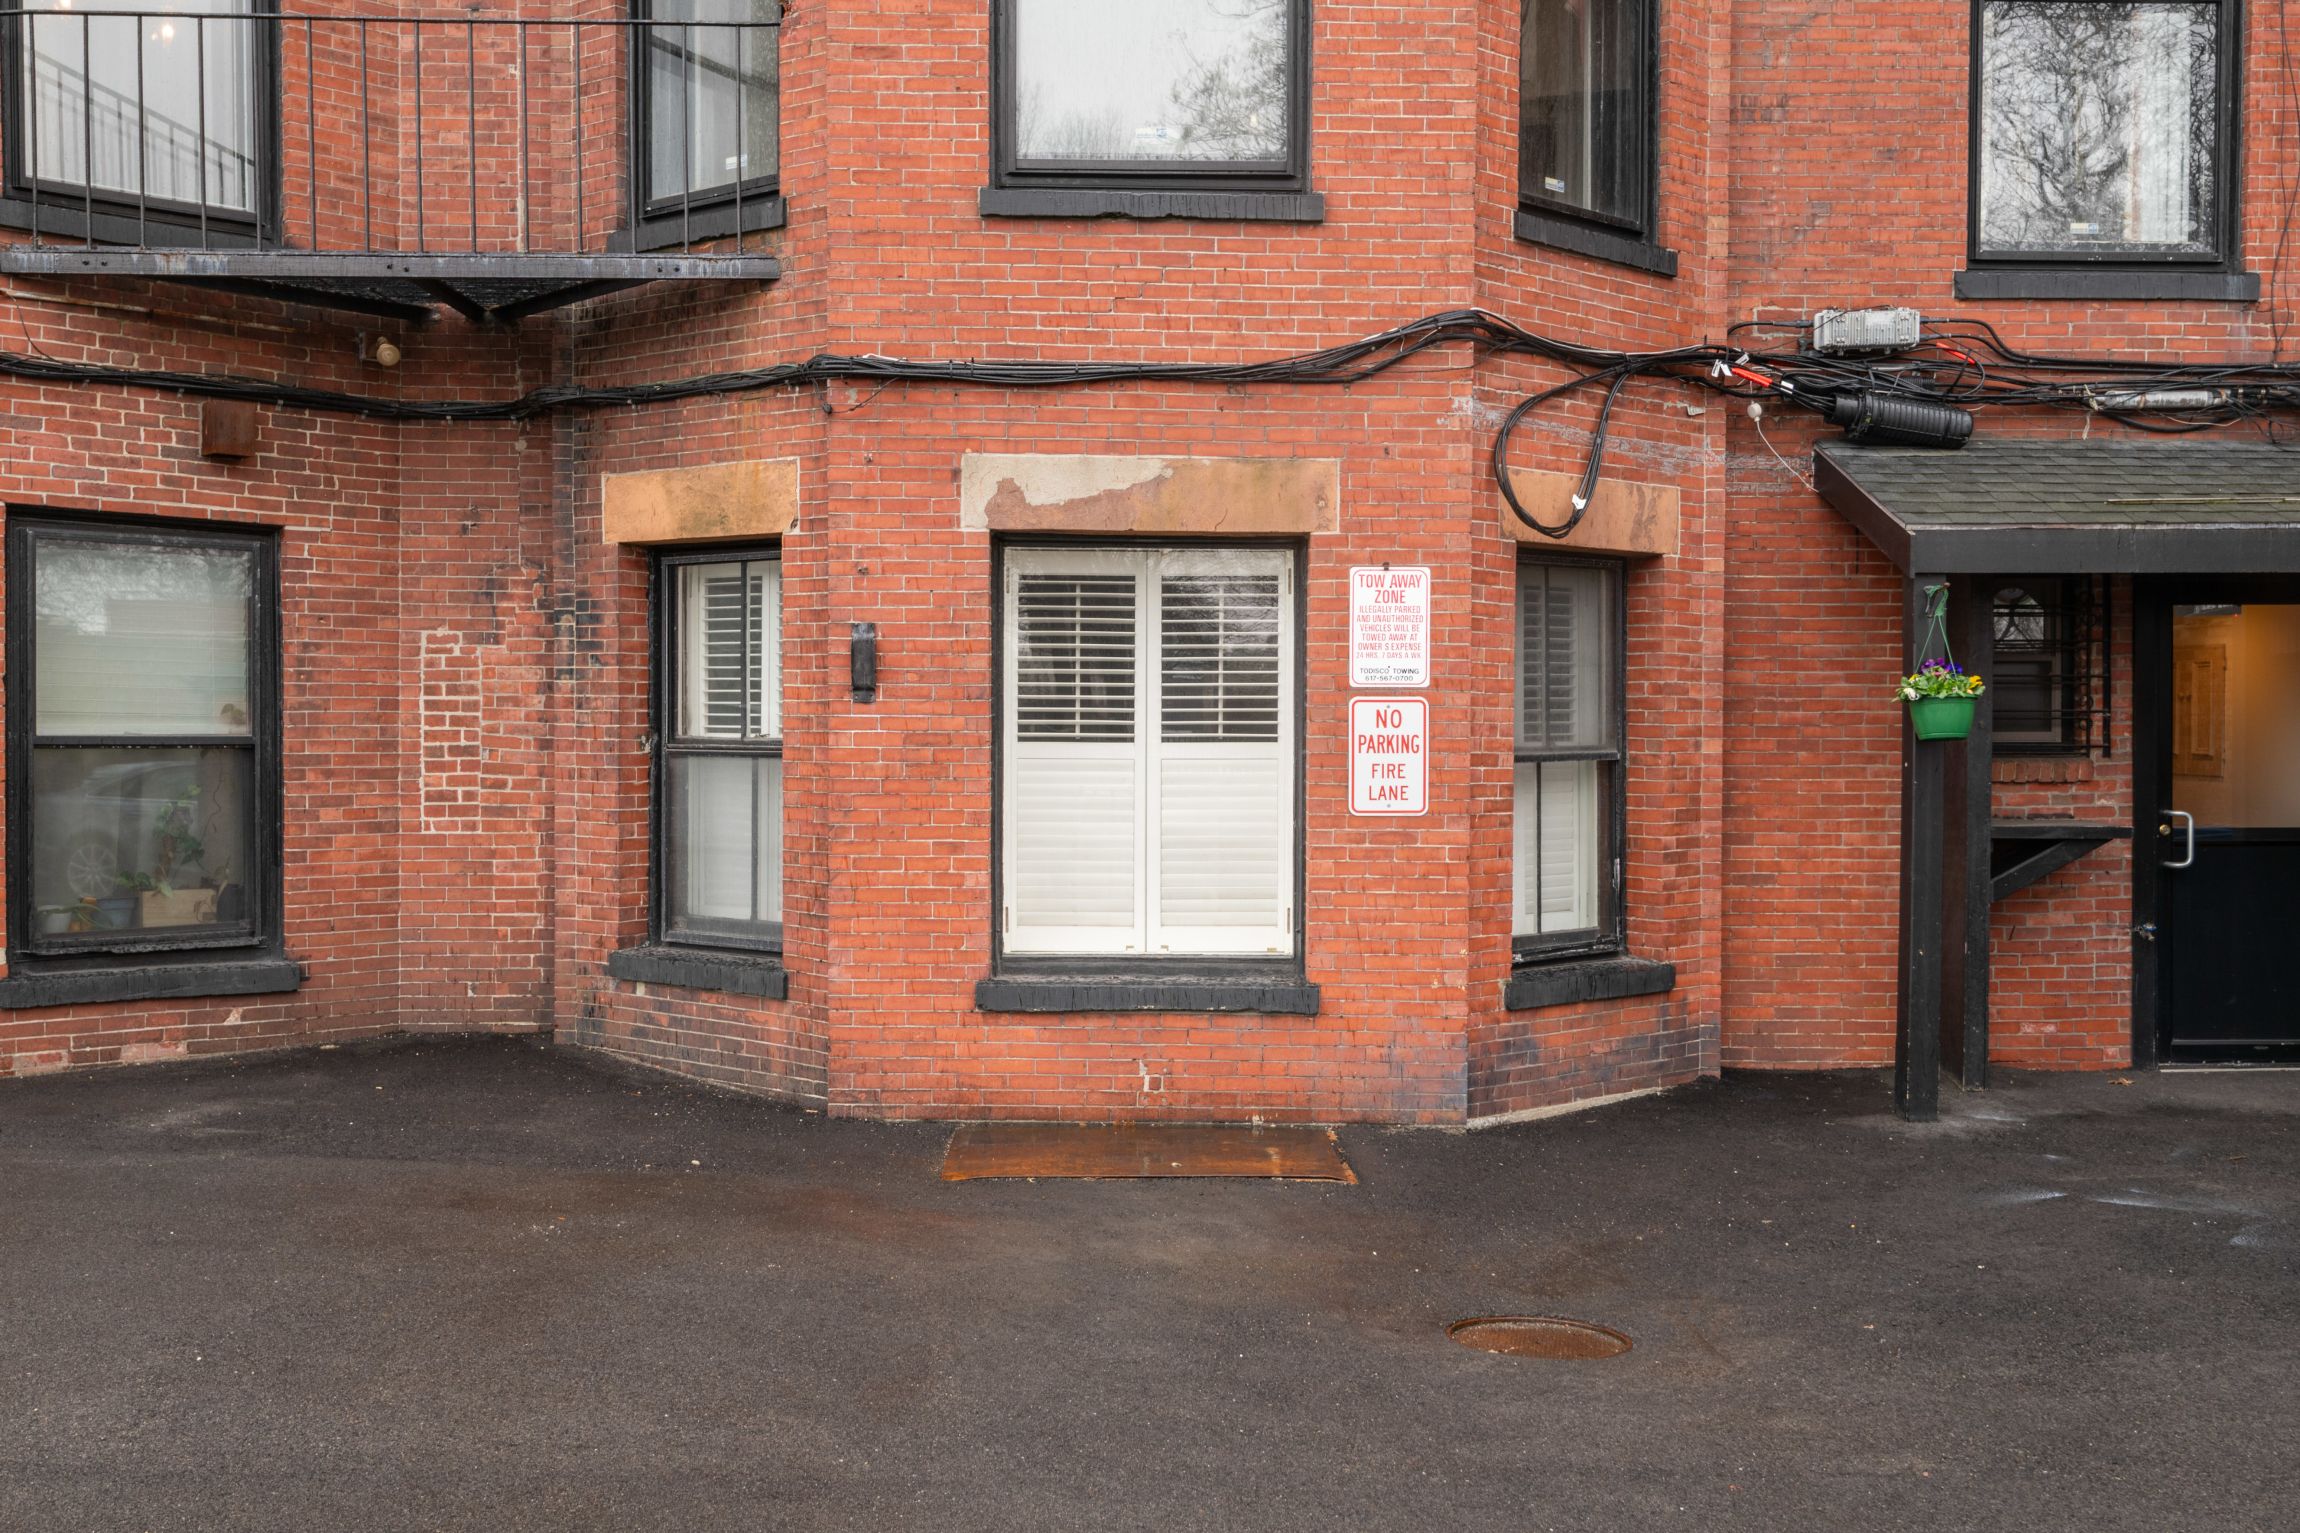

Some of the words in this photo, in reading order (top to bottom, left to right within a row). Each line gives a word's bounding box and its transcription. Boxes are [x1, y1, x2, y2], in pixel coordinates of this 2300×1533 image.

[1359, 574, 1384, 588] TOW
[1391, 574, 1422, 588] AWAY
[1375, 590, 1406, 603] ZONE
[1360, 605, 1392, 613] ILLEGALLY
[1394, 605, 1420, 613] PARKED
[1376, 709, 1402, 728] NO
[1358, 734, 1420, 754] PARKING
[1372, 764, 1406, 778] FIRE
[1369, 786, 1408, 800] LANE
